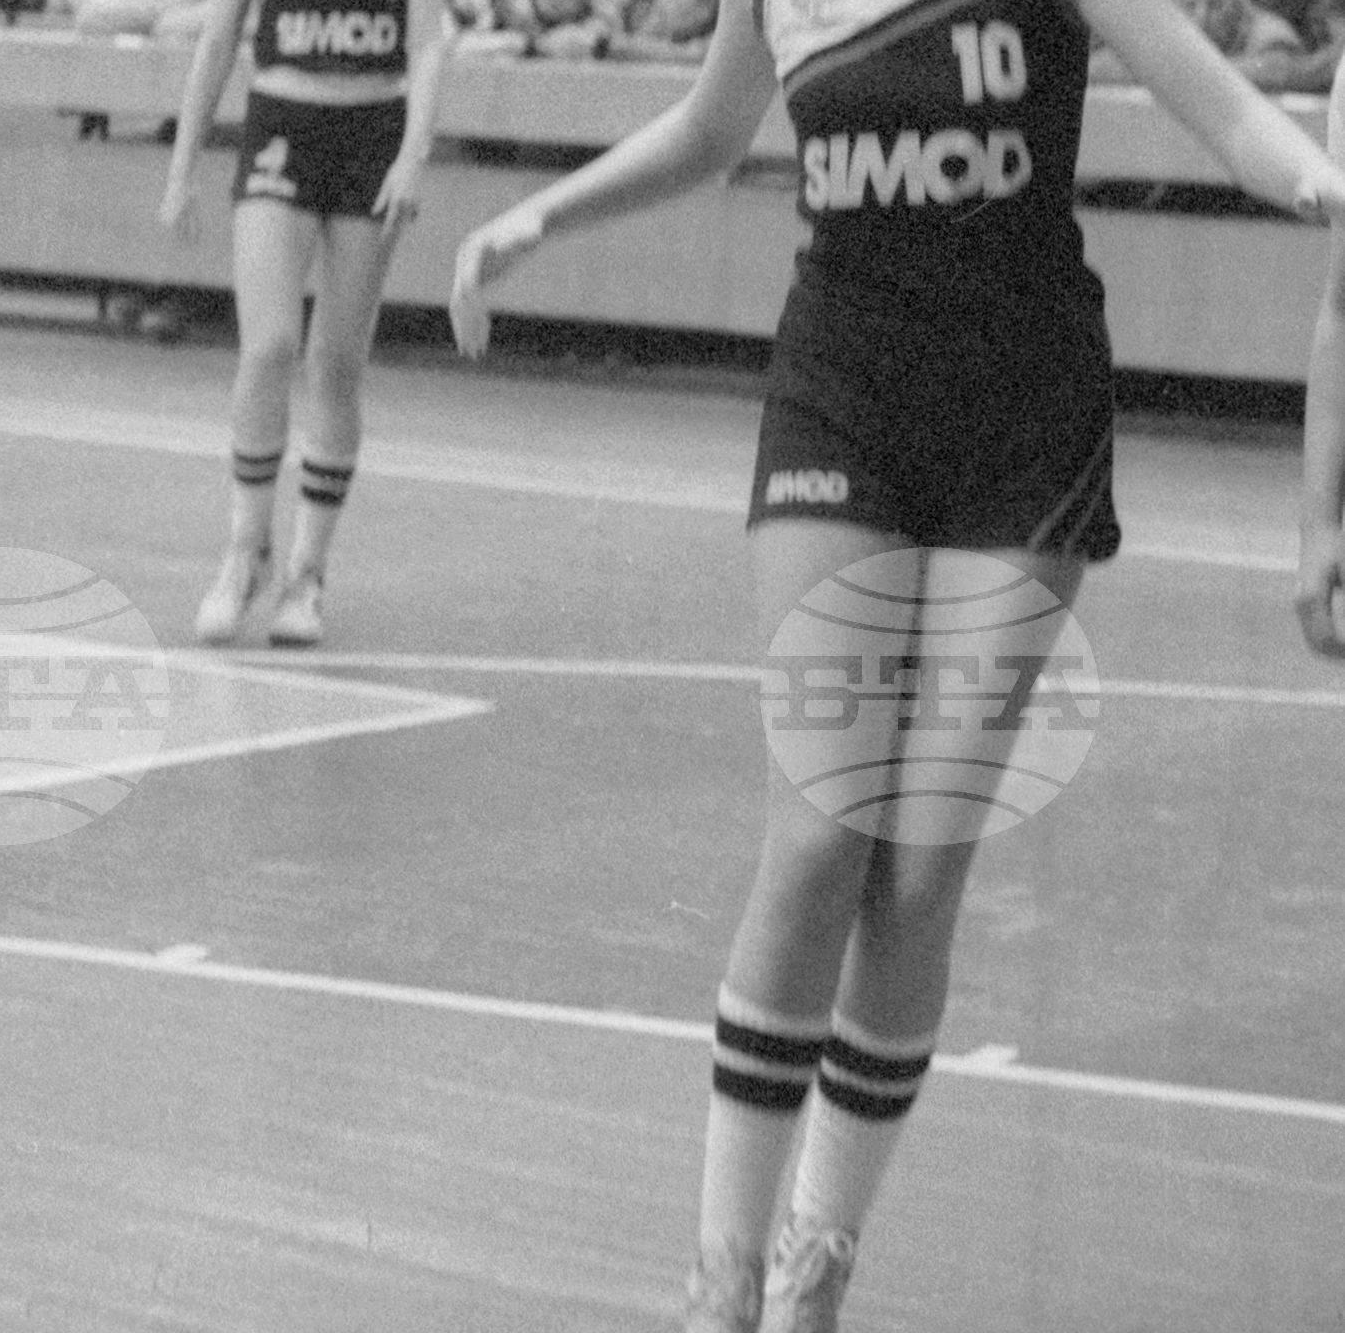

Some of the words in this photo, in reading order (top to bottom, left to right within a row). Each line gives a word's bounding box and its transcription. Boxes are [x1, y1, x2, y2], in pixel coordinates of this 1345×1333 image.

[276, 10, 398, 56] SIMOD
[951, 20, 1028, 106] 10
[804, 129, 1033, 211] SIMOD
